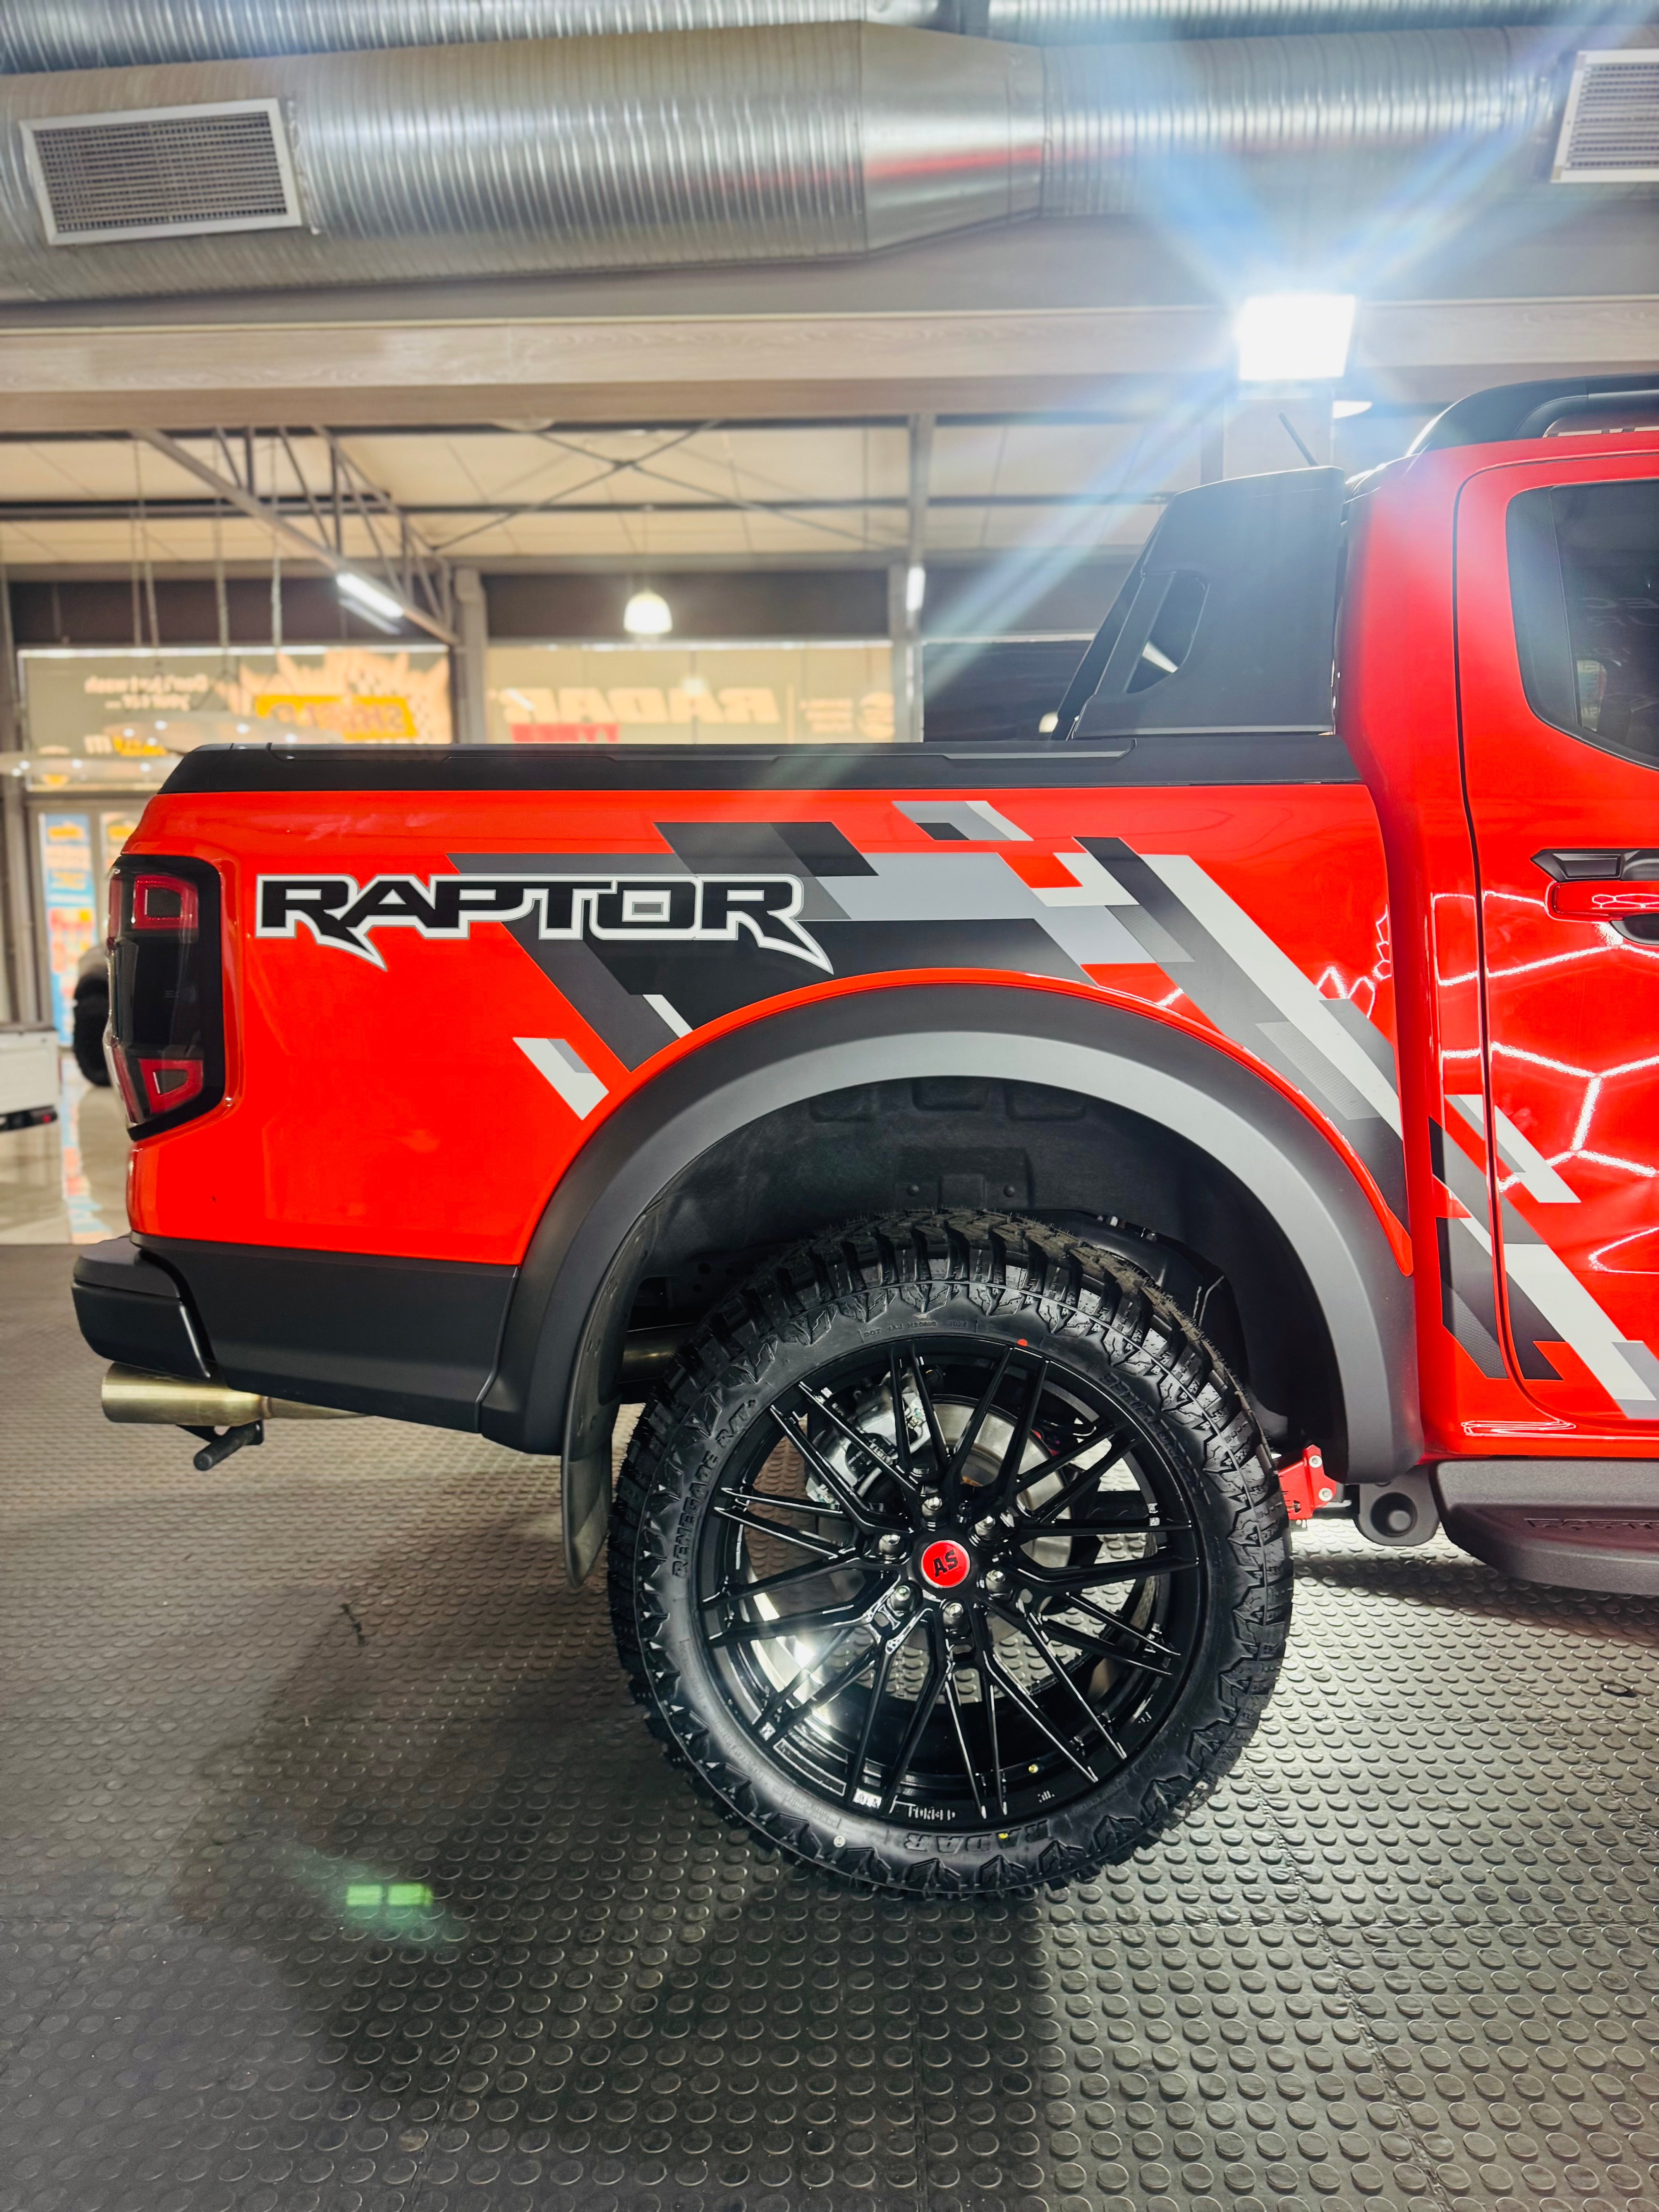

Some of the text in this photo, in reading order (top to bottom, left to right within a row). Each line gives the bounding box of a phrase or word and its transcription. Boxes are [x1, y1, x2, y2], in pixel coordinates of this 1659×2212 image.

[254, 873, 834, 974] RAPTOR
[671, 1450, 718, 1578] RENEGADE
[933, 1549, 958, 1578] AS
